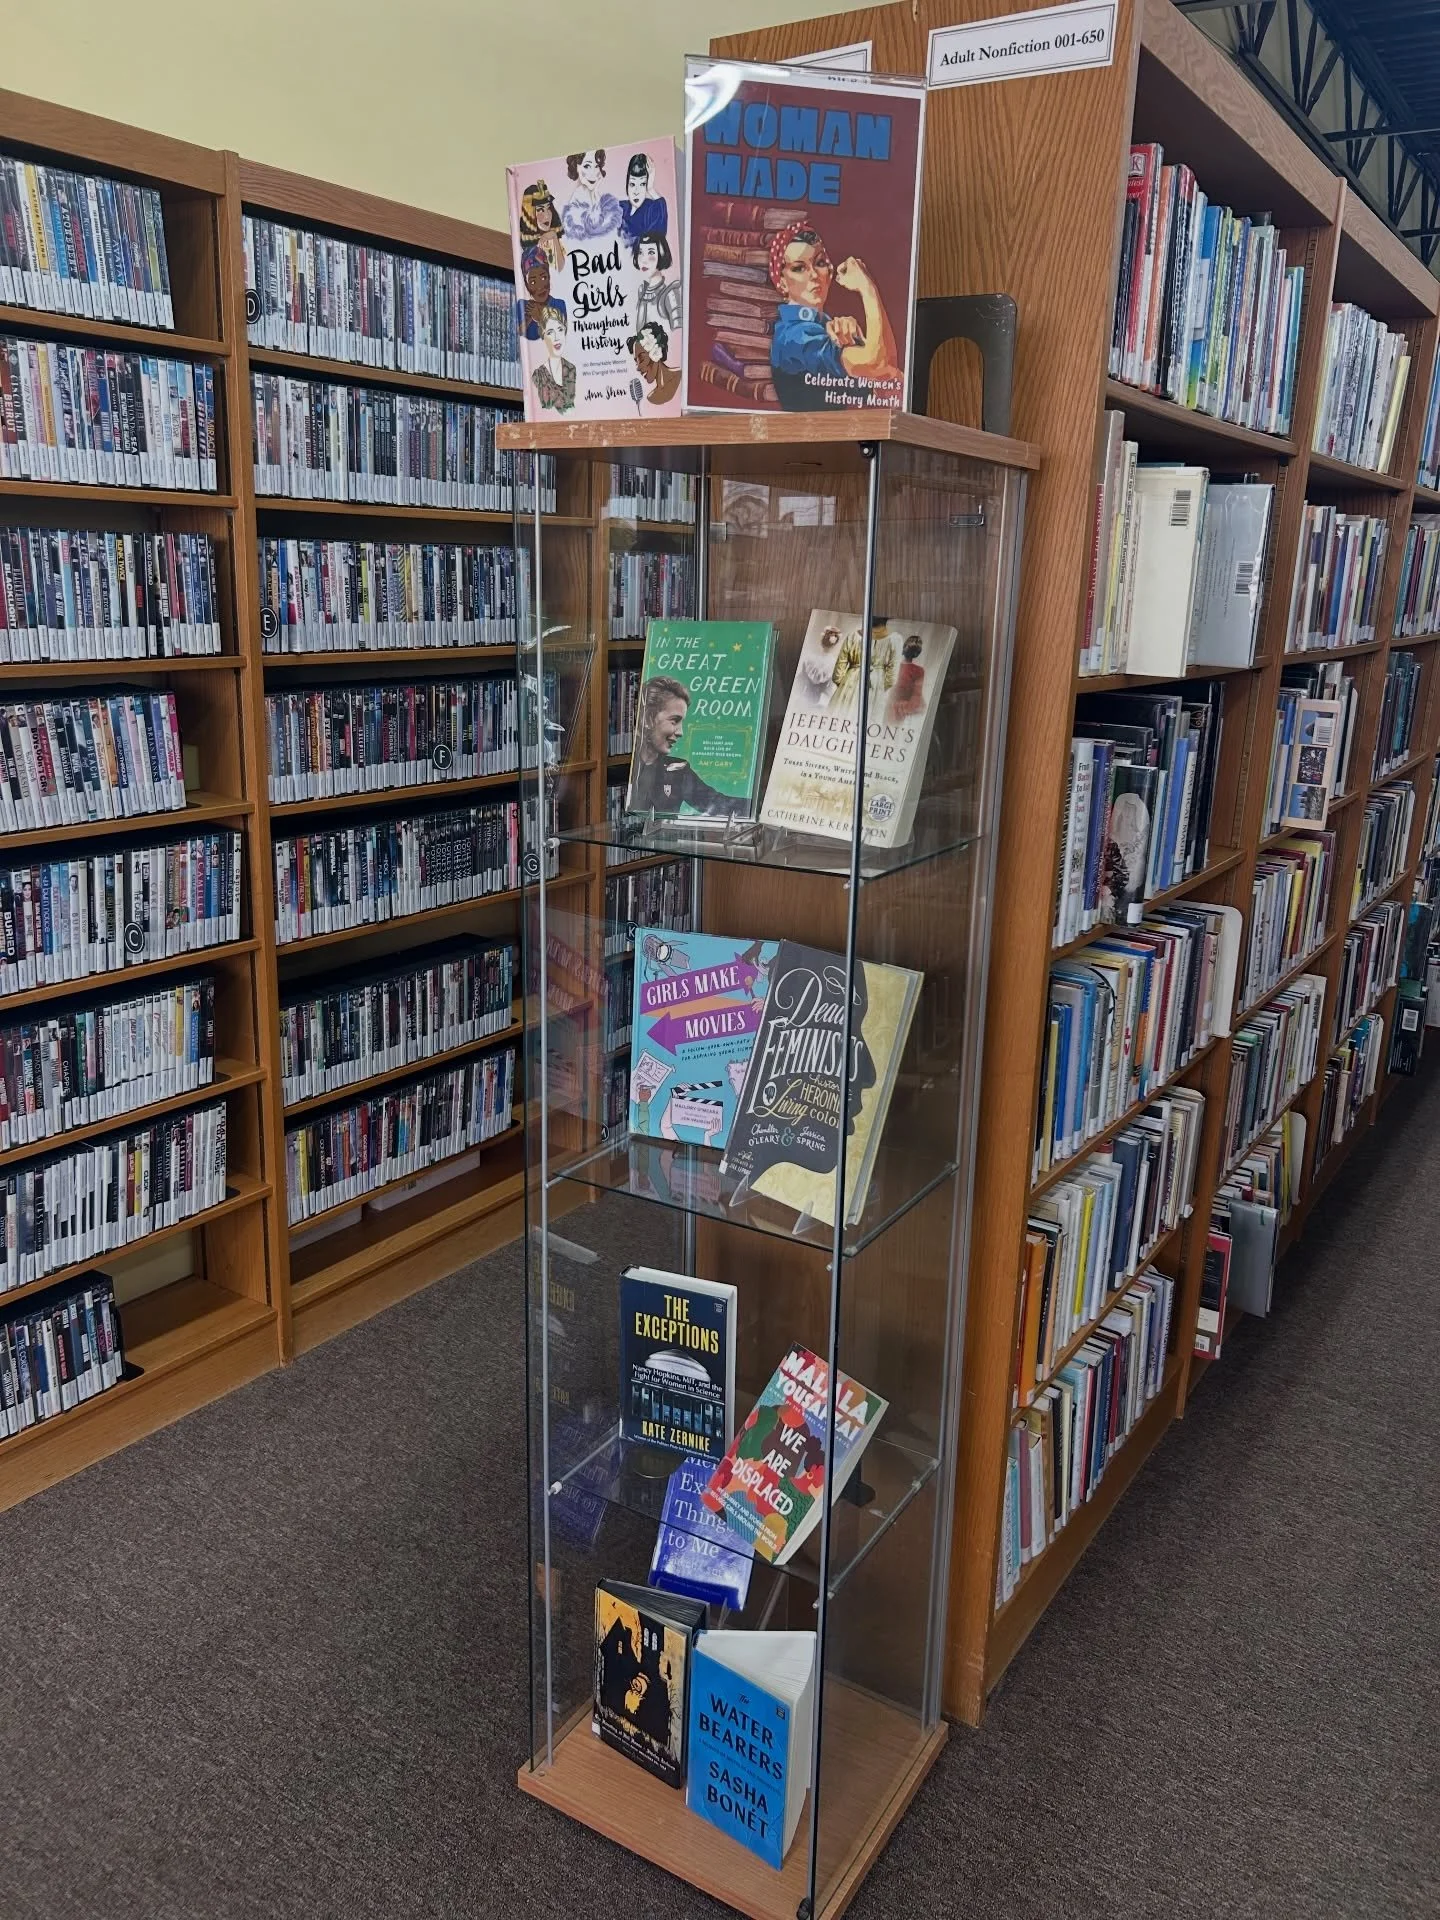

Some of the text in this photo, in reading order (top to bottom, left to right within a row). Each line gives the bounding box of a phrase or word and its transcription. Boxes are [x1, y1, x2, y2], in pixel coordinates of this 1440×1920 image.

[940, 28, 1105, 66] Adult Nonfiction 001-650
[703, 100, 892, 161] WOMAN
[705, 151, 841, 206] MADE
[61, 206, 77, 275] ATONEMENT
[113, 239, 125, 286] AVATAR
[567, 240, 622, 281] Bad
[573, 276, 628, 318] Girls
[573, 313, 630, 335] Throughout
[581, 336, 624, 355] History
[805, 372, 901, 390] Celebrate Women's
[3, 394, 16, 433] BEIRUT
[825, 391, 900, 408] History Month
[207, 420, 216, 459] MIRACLE
[4, 562, 17, 629] BLACKLIGHT
[263, 614, 270, 631] E
[656, 637, 702, 648] IN THE
[657, 653, 727, 671] GREAT
[689, 676, 761, 694] GREEN
[692, 700, 752, 717] ROOM
[86, 740, 98, 779] BREACH
[147, 727, 159, 782] BRIAN BANKS
[440, 750, 446, 763] F
[787, 731, 906, 763] DAUGHERS
[39, 776, 47, 793] CRY
[767, 809, 825, 828] CATHERINE
[869, 807, 891, 817] PRINT
[871, 800, 892, 810] LARGE
[528, 858, 537, 871] G
[4, 911, 15, 956] BURIED
[129, 930, 139, 947] C
[628, 926, 635, 937] K
[646, 966, 740, 1006] GIRLS MAKE
[685, 1010, 746, 1039] MOVIES
[63, 1060, 71, 1099] CHAPPIE
[753, 1079, 808, 1126] Living
[800, 1082, 840, 1113] HEROIN
[749, 1135, 780, 1146] O'LEARY
[751, 1123, 779, 1135] Chandler
[800, 1126, 826, 1141] Jessica
[796, 1136, 826, 1152] SPRING
[663, 1294, 690, 1322] THE
[635, 1312, 719, 1355] EXCEPTIONS
[632, 1363, 651, 1374] Nancy
[653, 1368, 681, 1381] Hopkins,
[682, 1377, 697, 1387] MIT,
[711, 1384, 722, 1392] the
[634, 1371, 650, 1381] Fight
[651, 1374, 660, 1383] for
[661, 1377, 687, 1390] Women
[696, 1387, 720, 1399] Science
[642, 1420, 710, 1452] KATE ZERNIKE
[780, 1424, 806, 1454] WE
[761, 1449, 792, 1478] ARE
[731, 1457, 794, 1516] DISPLACED
[740, 1507, 749, 1517] AND
[763, 1526, 777, 1540] FROM
[667, 1530, 720, 1558] to Me
[710, 1692, 773, 1750] WATER
[700, 1712, 782, 1780] BEARERS
[709, 1760, 768, 1815] SASHA
